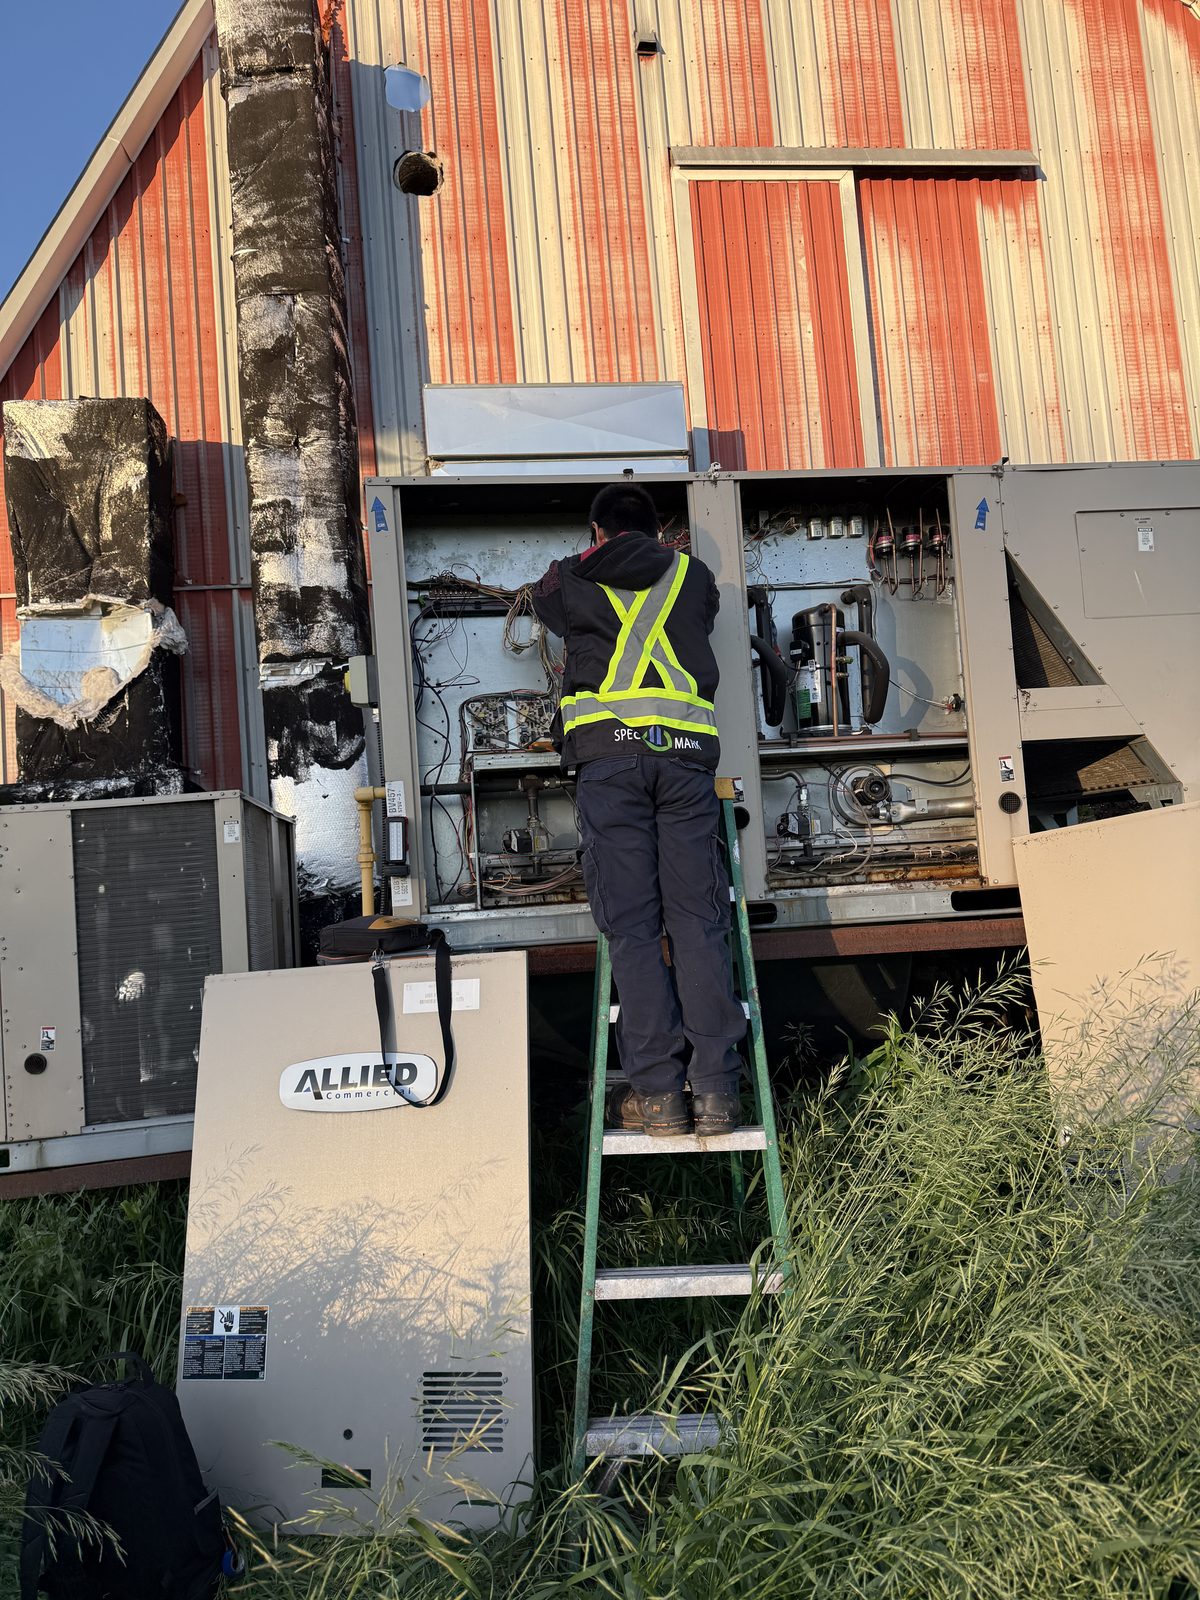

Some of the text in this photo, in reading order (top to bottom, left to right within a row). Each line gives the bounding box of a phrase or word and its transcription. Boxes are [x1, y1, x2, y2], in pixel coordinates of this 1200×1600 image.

[614, 728, 702, 751] SPEC MARK
[293, 1062, 418, 1101] ALLIED
[326, 1087, 411, 1100] Commercial
